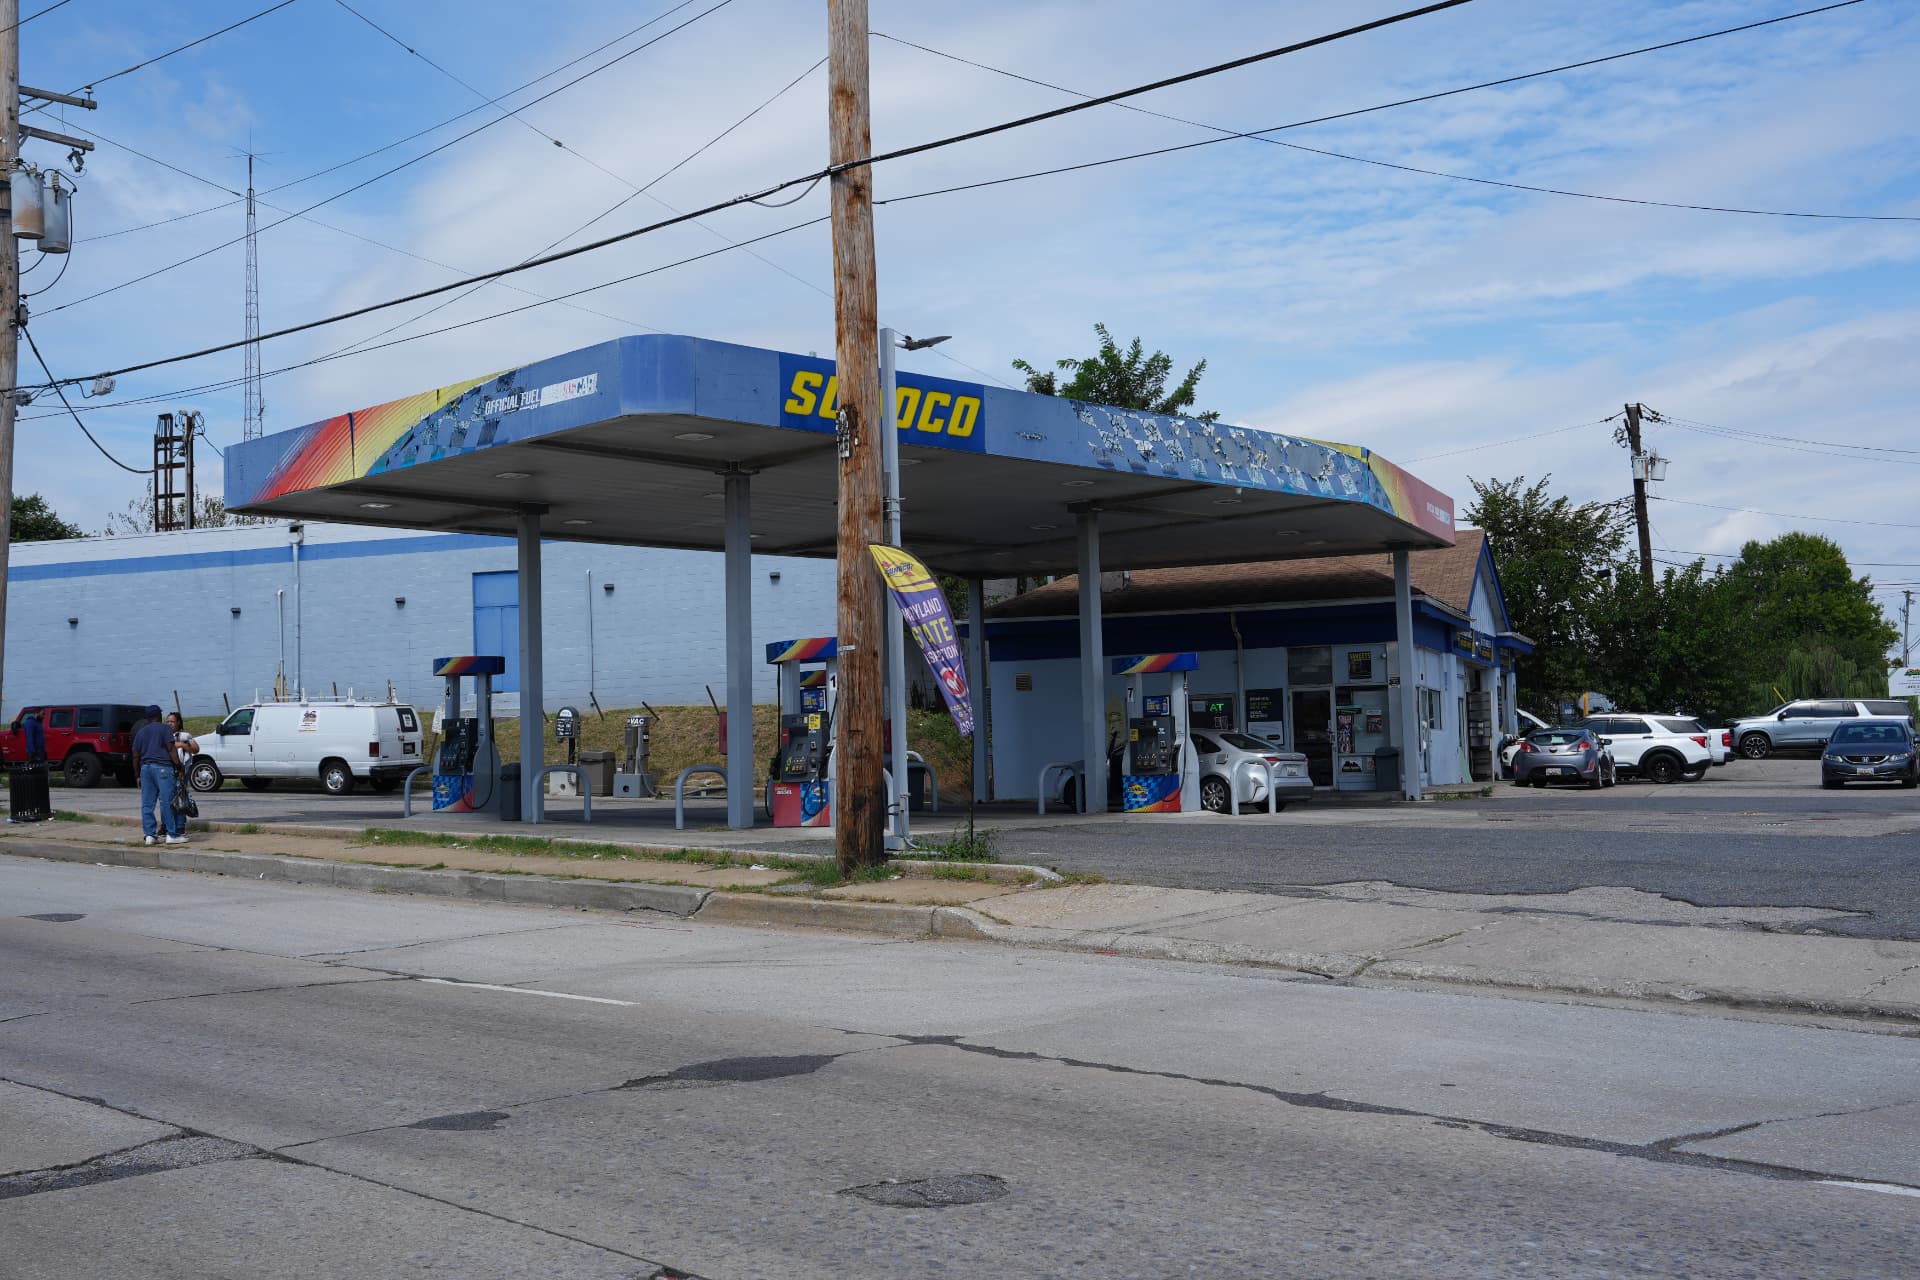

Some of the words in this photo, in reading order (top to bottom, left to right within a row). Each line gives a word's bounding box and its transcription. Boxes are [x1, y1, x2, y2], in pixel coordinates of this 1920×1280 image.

[485, 395, 519, 415] OFFICIAL
[519, 388, 540, 406] FUEL
[830, 675, 836, 688] 1
[1127, 687, 1134, 698] 7
